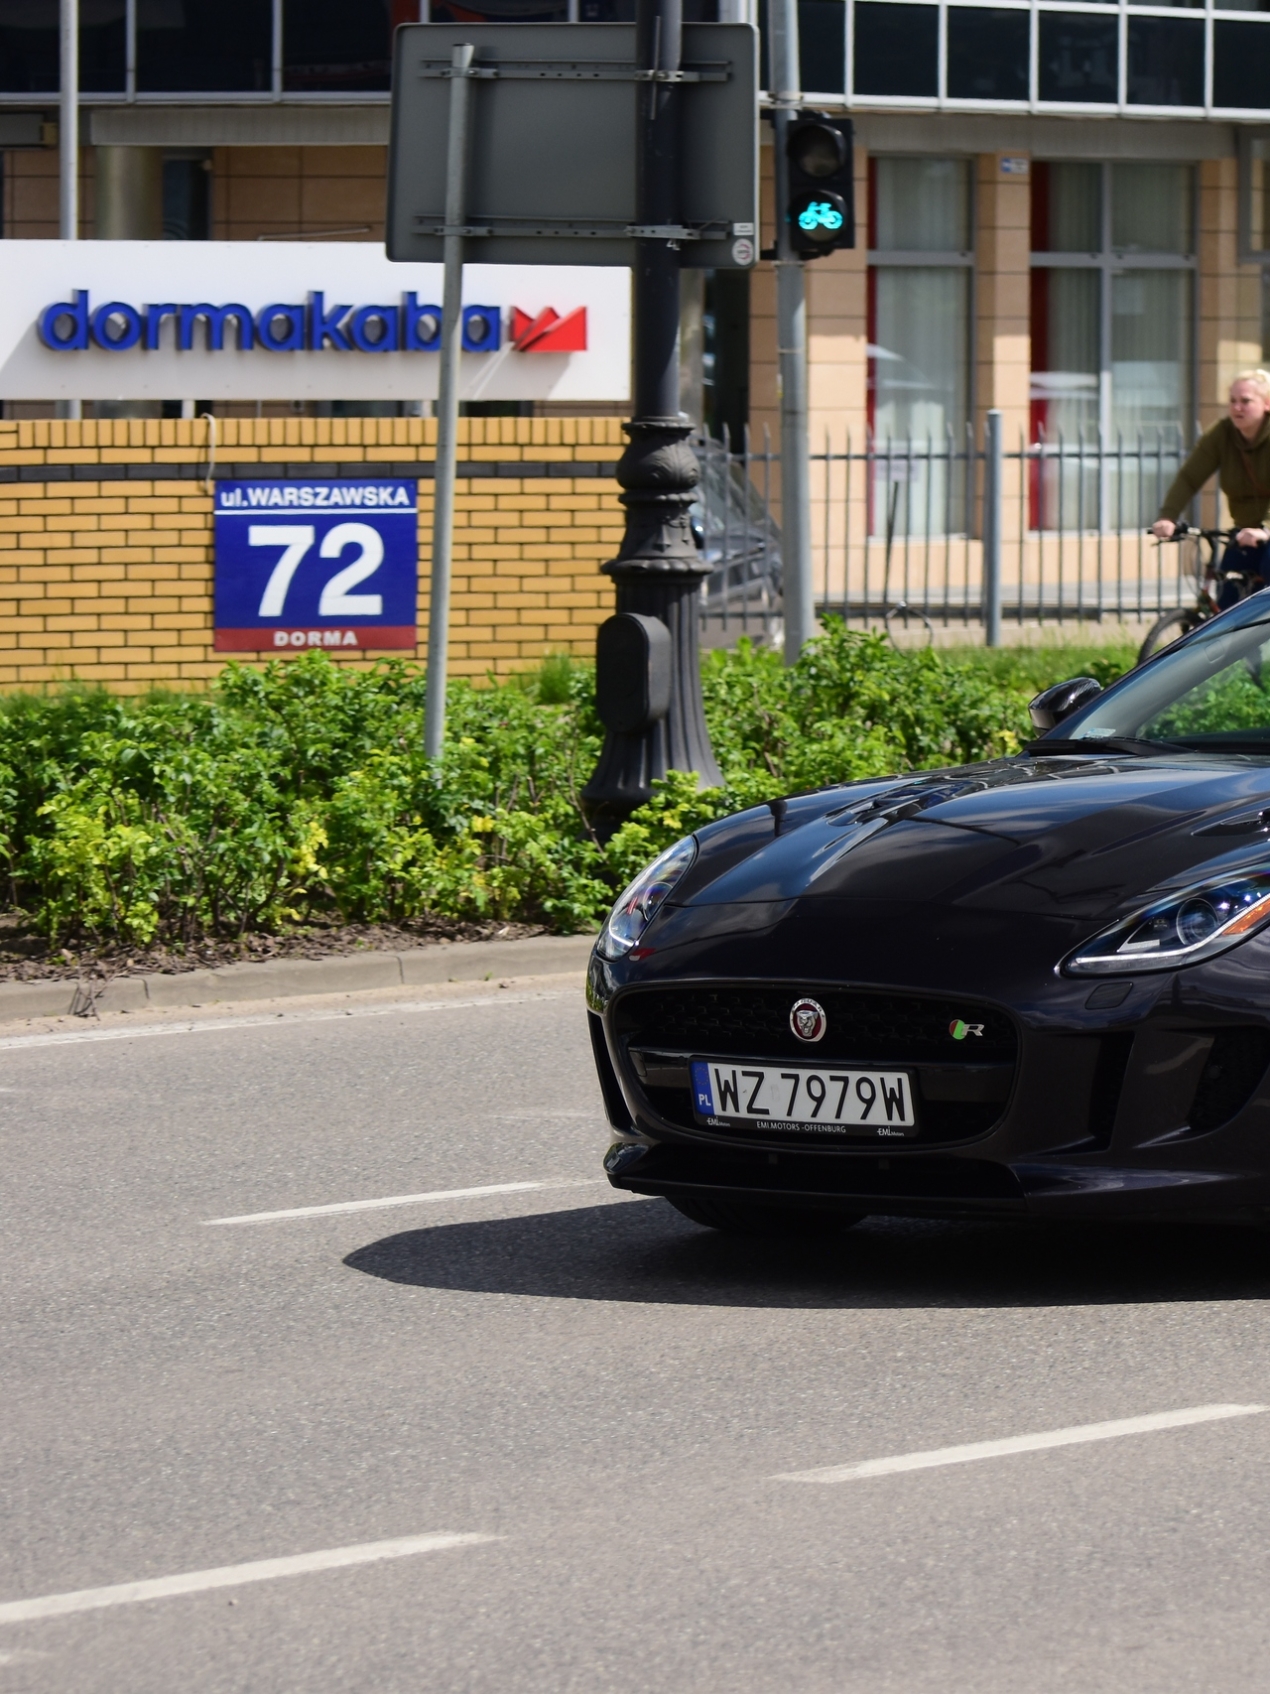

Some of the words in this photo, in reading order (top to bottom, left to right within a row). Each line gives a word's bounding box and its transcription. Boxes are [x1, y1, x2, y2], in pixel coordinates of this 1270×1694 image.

[38, 288, 501, 353] dormakaba
[220, 486, 410, 508] ul.WARSZAWSKA
[248, 522, 385, 618] 72
[273, 631, 358, 647] DORMA
[961, 1024, 985, 1037] R
[698, 1093, 711, 1106] PL
[714, 1068, 770, 1115] WZ
[781, 1073, 906, 1121] 7979W
